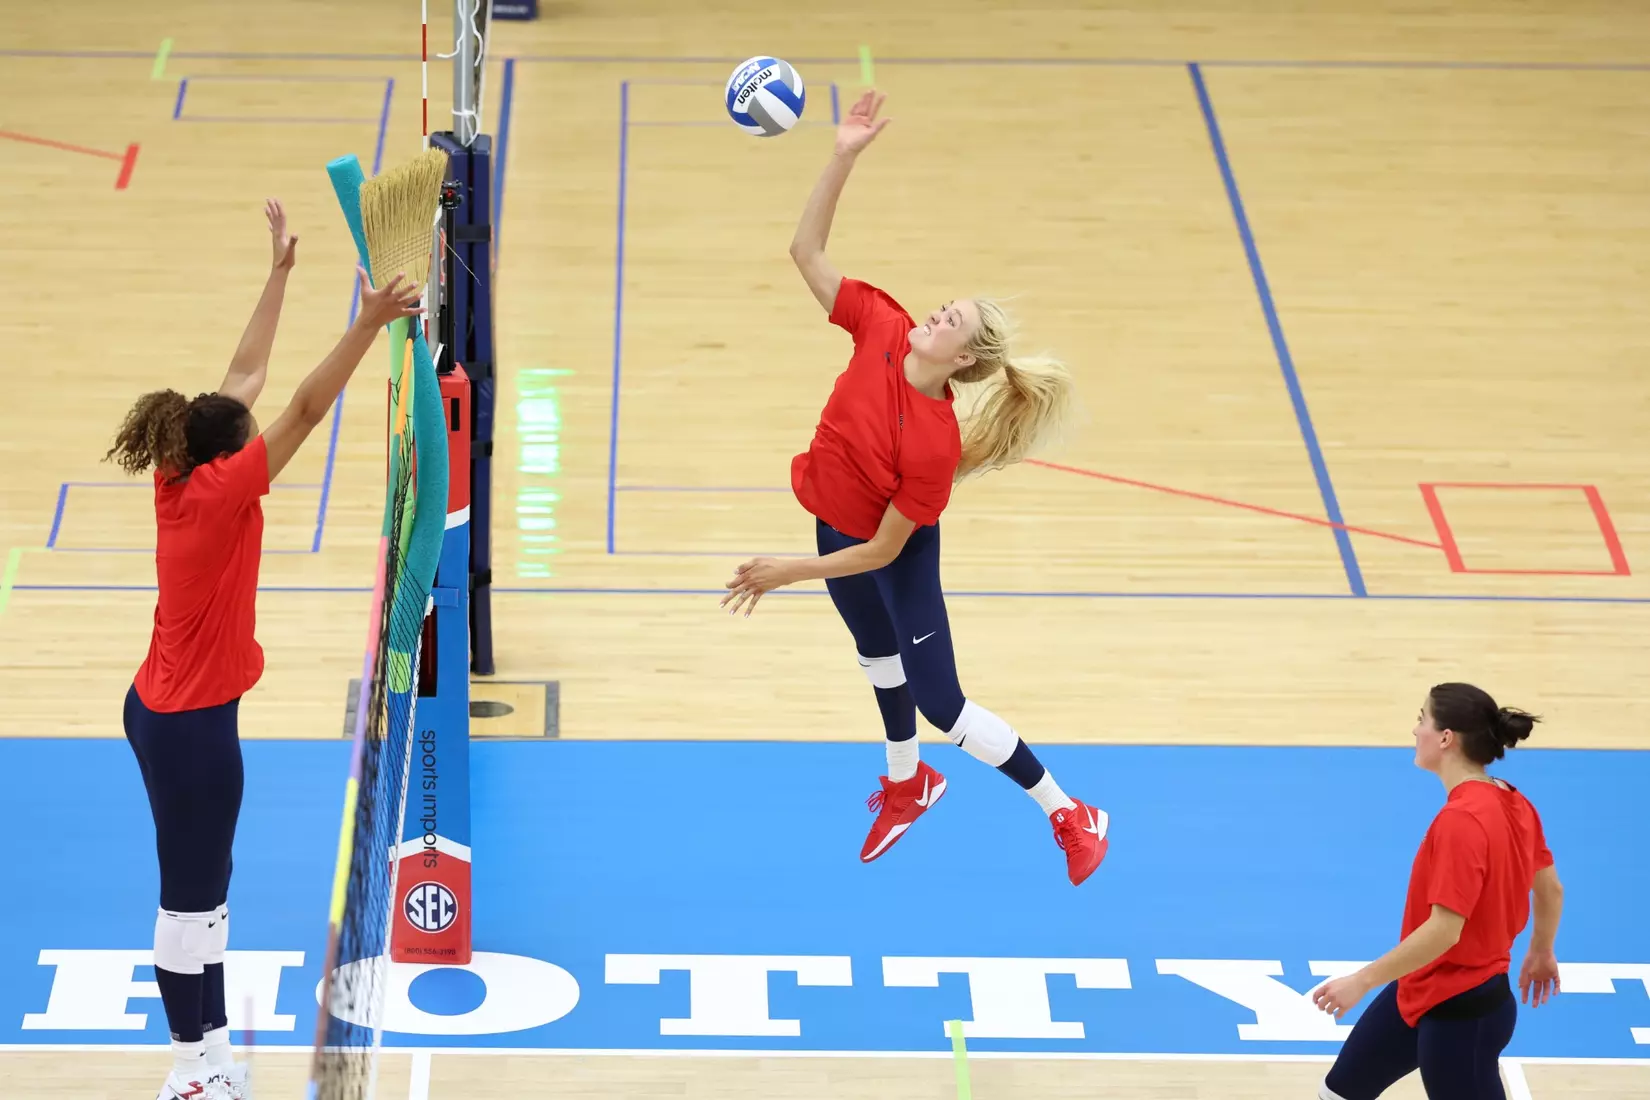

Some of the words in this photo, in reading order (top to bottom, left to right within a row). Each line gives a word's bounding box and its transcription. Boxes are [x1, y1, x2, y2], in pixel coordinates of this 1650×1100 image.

[737, 68, 773, 105] molten
[418, 729, 439, 791] sports
[419, 793, 440, 869] imports
[408, 885, 453, 930] SEC
[21, 949, 1376, 1042] HOTTY
